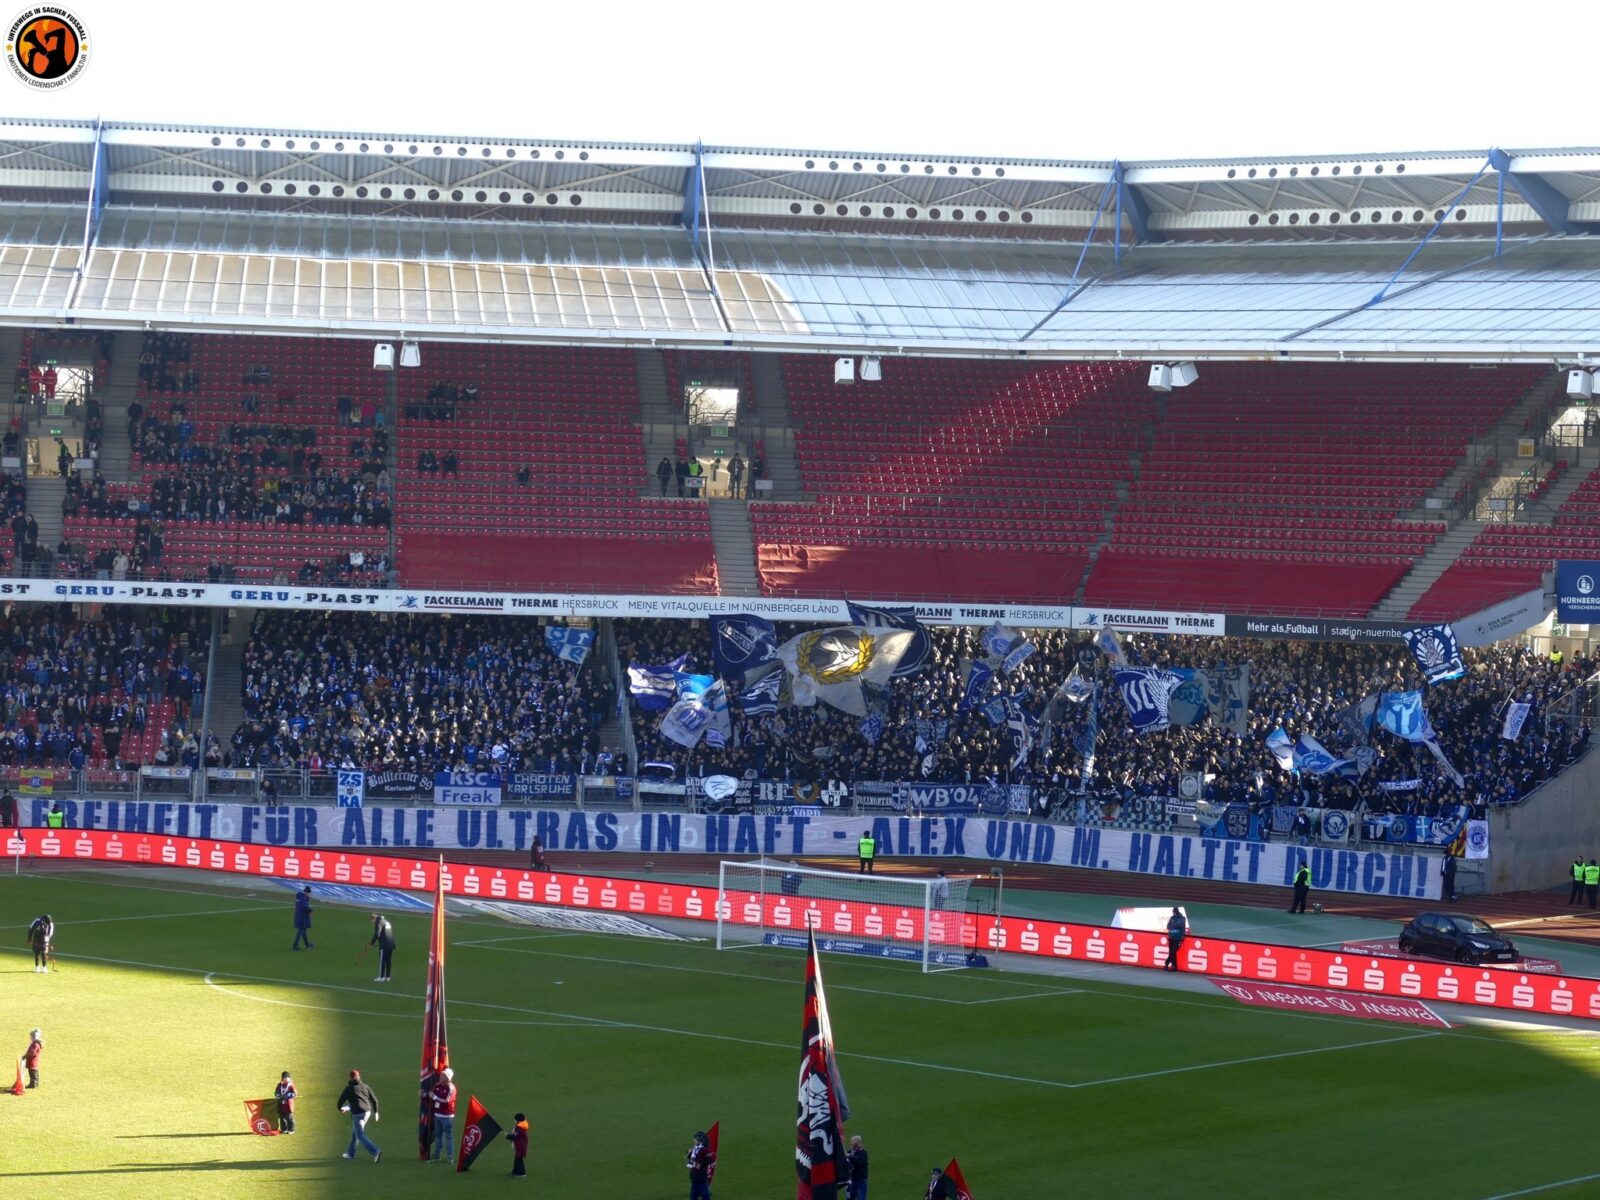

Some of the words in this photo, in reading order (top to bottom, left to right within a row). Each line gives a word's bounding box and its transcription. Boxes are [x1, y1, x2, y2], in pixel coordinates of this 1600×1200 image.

[424, 596, 503, 607] FACKELMANN
[511, 598, 558, 608] THERME
[562, 600, 618, 610] HERSBRUCK
[628, 600, 658, 610] MEINE
[660, 601, 725, 612] VITALQUELLE
[728, 603, 739, 612] IM
[742, 601, 809, 613] NÜRNBERGER
[916, 607, 952, 617] MANN
[960, 608, 1005, 618] THERME
[1009, 609, 1064, 620] HERSBRUCK
[1103, 613, 1169, 626] FACKELMANN
[1175, 617, 1214, 628] THERME
[1247, 622, 1269, 633] Mehr
[1272, 623, 1284, 633] als
[1286, 624, 1318, 635] Fußball
[1331, 626, 1403, 638] stadion-nuernbe
[450, 772, 487, 785] KSC
[514, 774, 571, 784] CHAOTEN
[507, 784, 572, 794] KARLSRUHE
[443, 790, 493, 803] Freak
[32, 798, 218, 840] FREIHEIT
[242, 805, 318, 846] FÜR
[342, 808, 434, 847] ALLE
[457, 809, 618, 851] ULTRAS
[641, 813, 681, 852] IN
[705, 813, 811, 854] HAFT
[872, 817, 966, 856] ALEX
[986, 820, 1055, 863] UND
[1072, 827, 1109, 869] M.
[1129, 832, 1266, 883] HALTET
[1285, 846, 1428, 898] DURCH!
